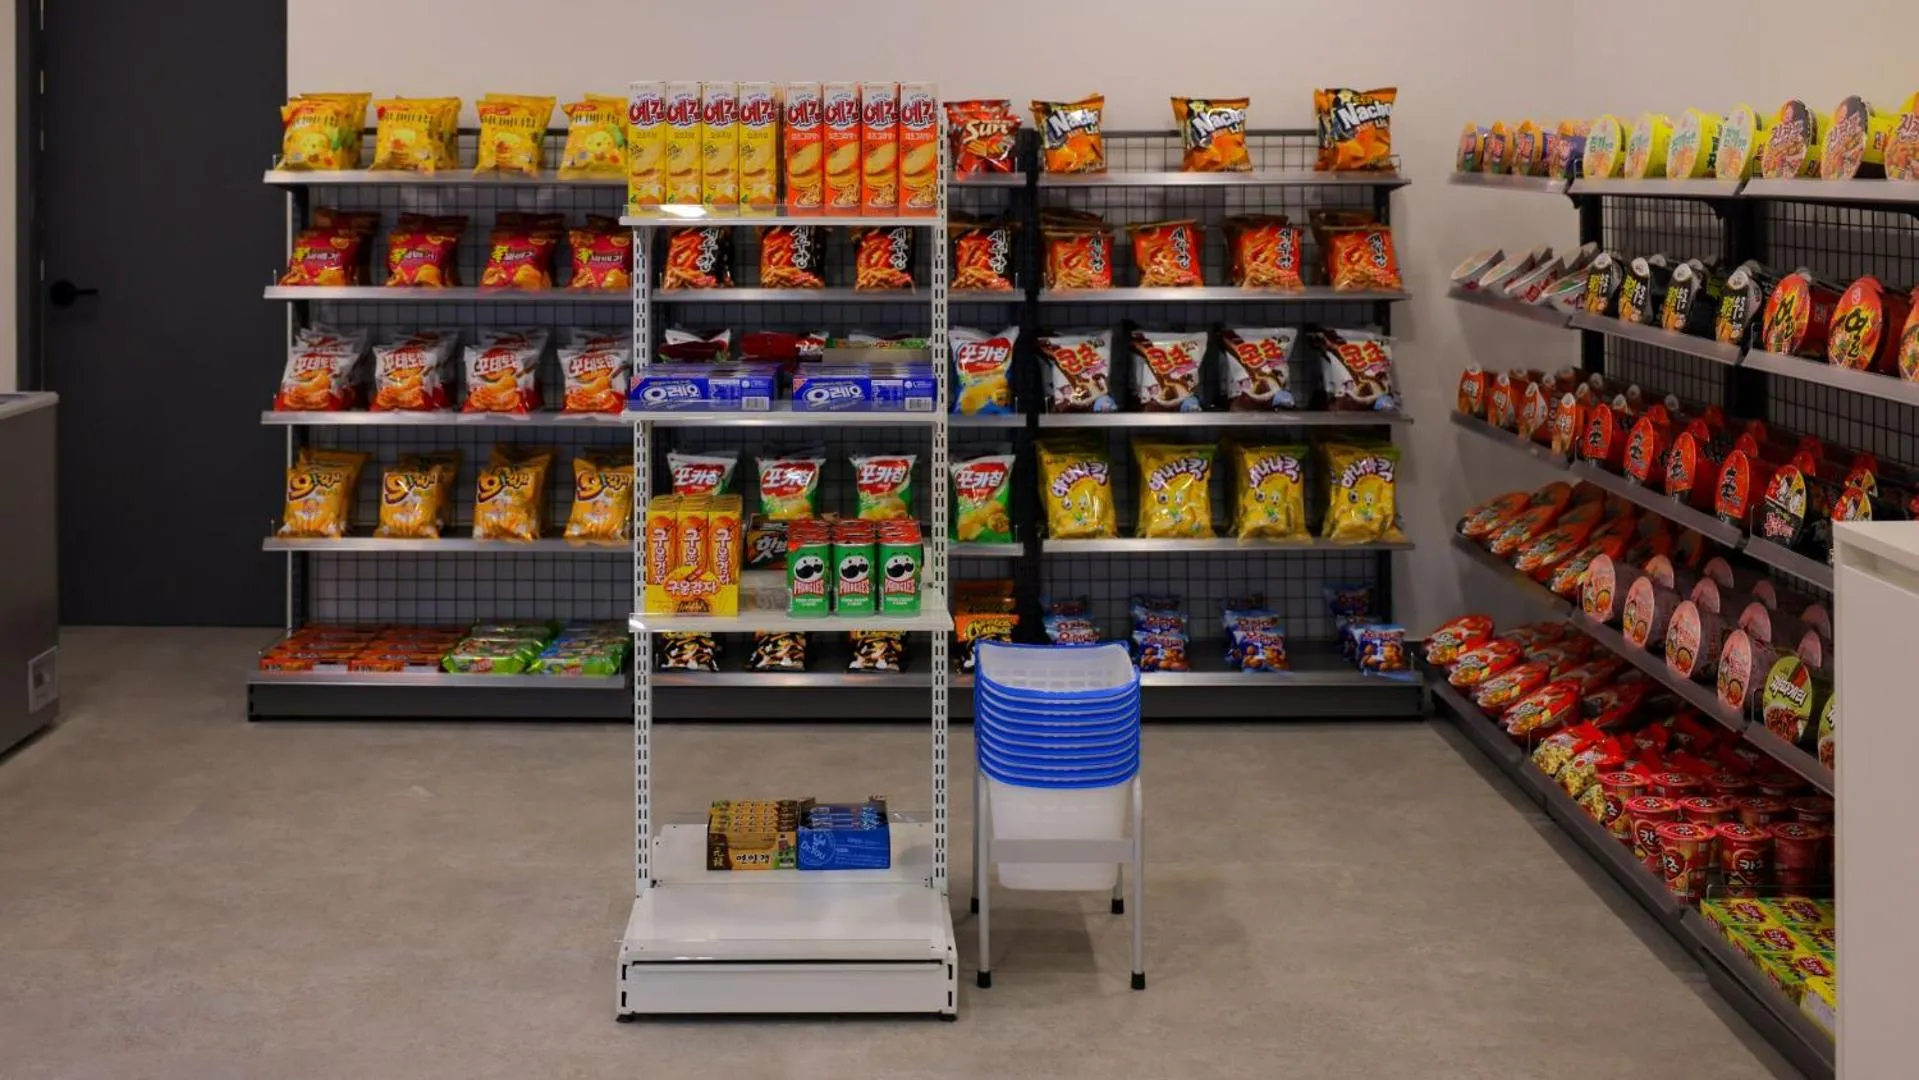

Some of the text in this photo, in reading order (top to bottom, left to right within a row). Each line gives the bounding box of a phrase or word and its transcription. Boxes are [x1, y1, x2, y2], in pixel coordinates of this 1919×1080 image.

[964, 120, 1011, 143] Sun
[961, 345, 1008, 362] 포카칩
[674, 467, 721, 486] 포카칩
[763, 467, 813, 488] 포카칩
[860, 464, 906, 484] 포카칩
[958, 470, 1003, 488] 포카칩
[668, 581, 715, 596] 구운감자
